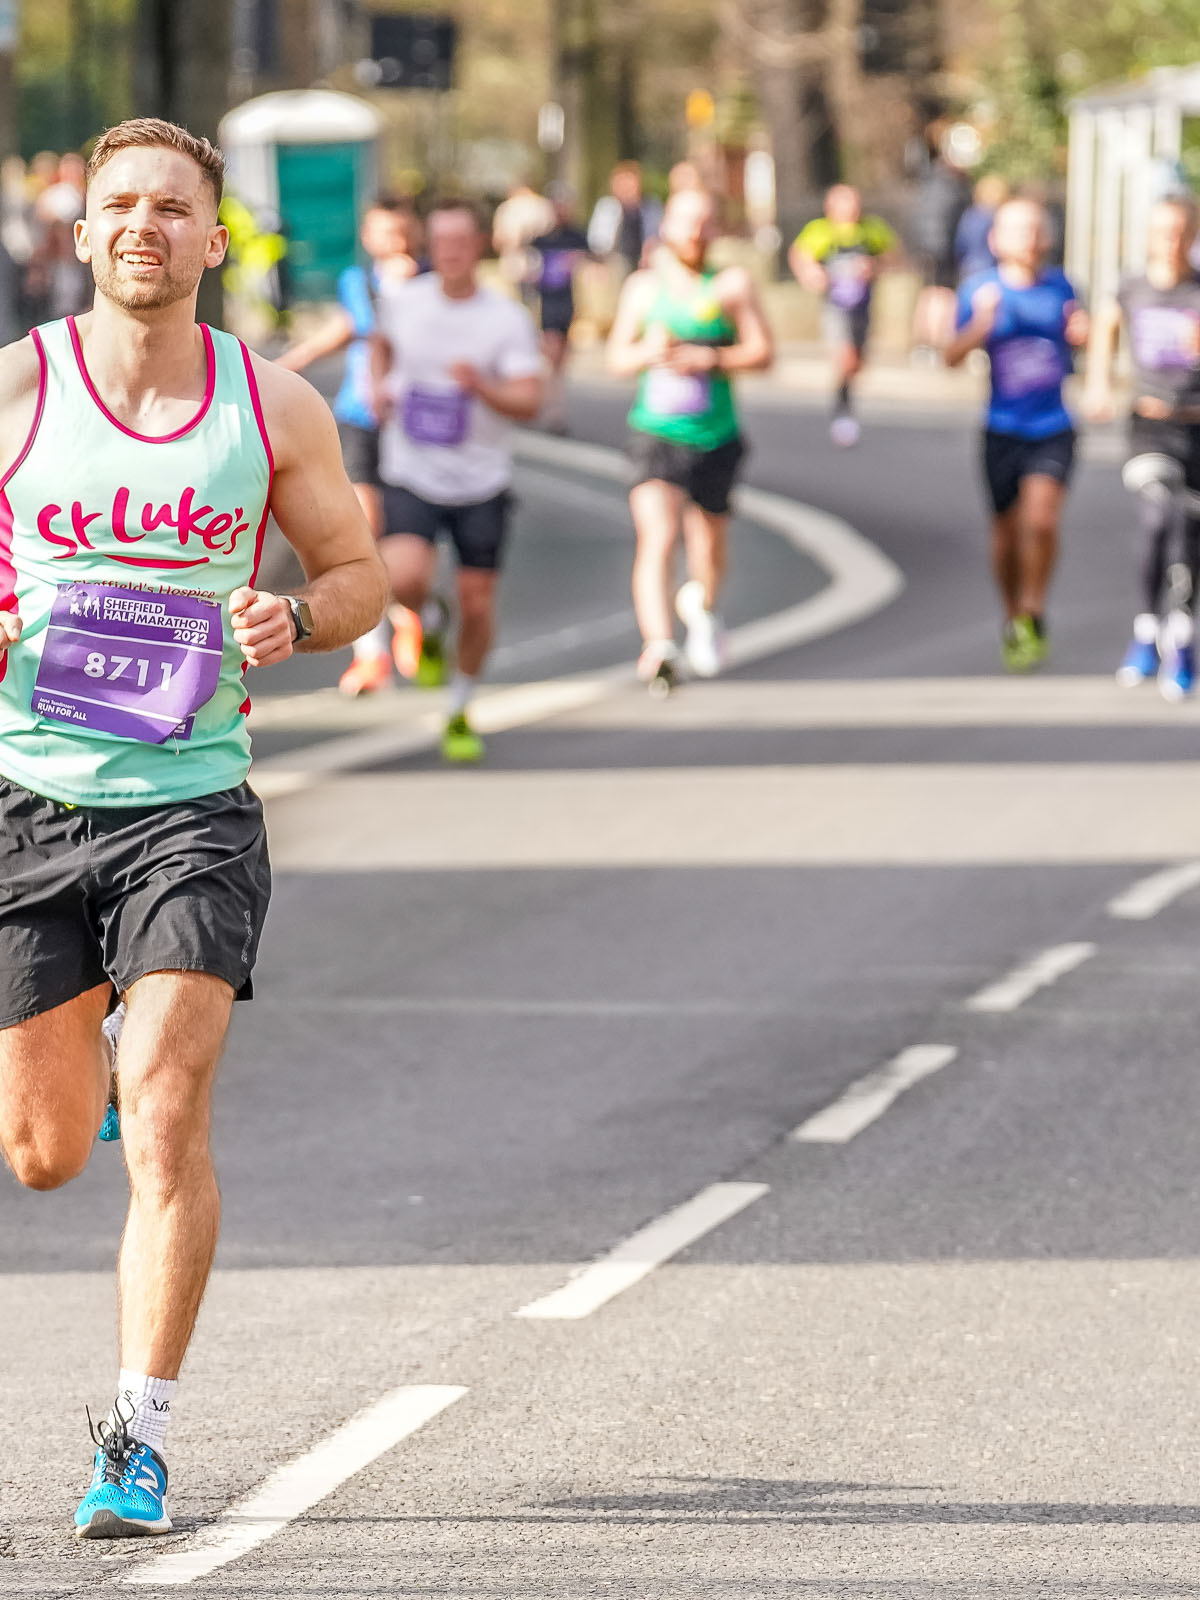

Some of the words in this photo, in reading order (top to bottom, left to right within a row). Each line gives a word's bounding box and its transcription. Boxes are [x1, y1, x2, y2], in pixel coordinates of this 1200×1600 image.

[111, 486, 250, 556] Luke's
[73, 580, 155, 593] field's
[159, 585, 216, 599] Hospice
[105, 598, 163, 614] SHEFFIELD
[103, 609, 135, 623] HALF
[136, 614, 208, 632] MARATHON
[172, 630, 208, 645] 2022
[83, 651, 174, 692] 8711
[38, 703, 55, 712] RUN
[56, 707, 71, 717] FOR
[73, 711, 87, 720] ALL
